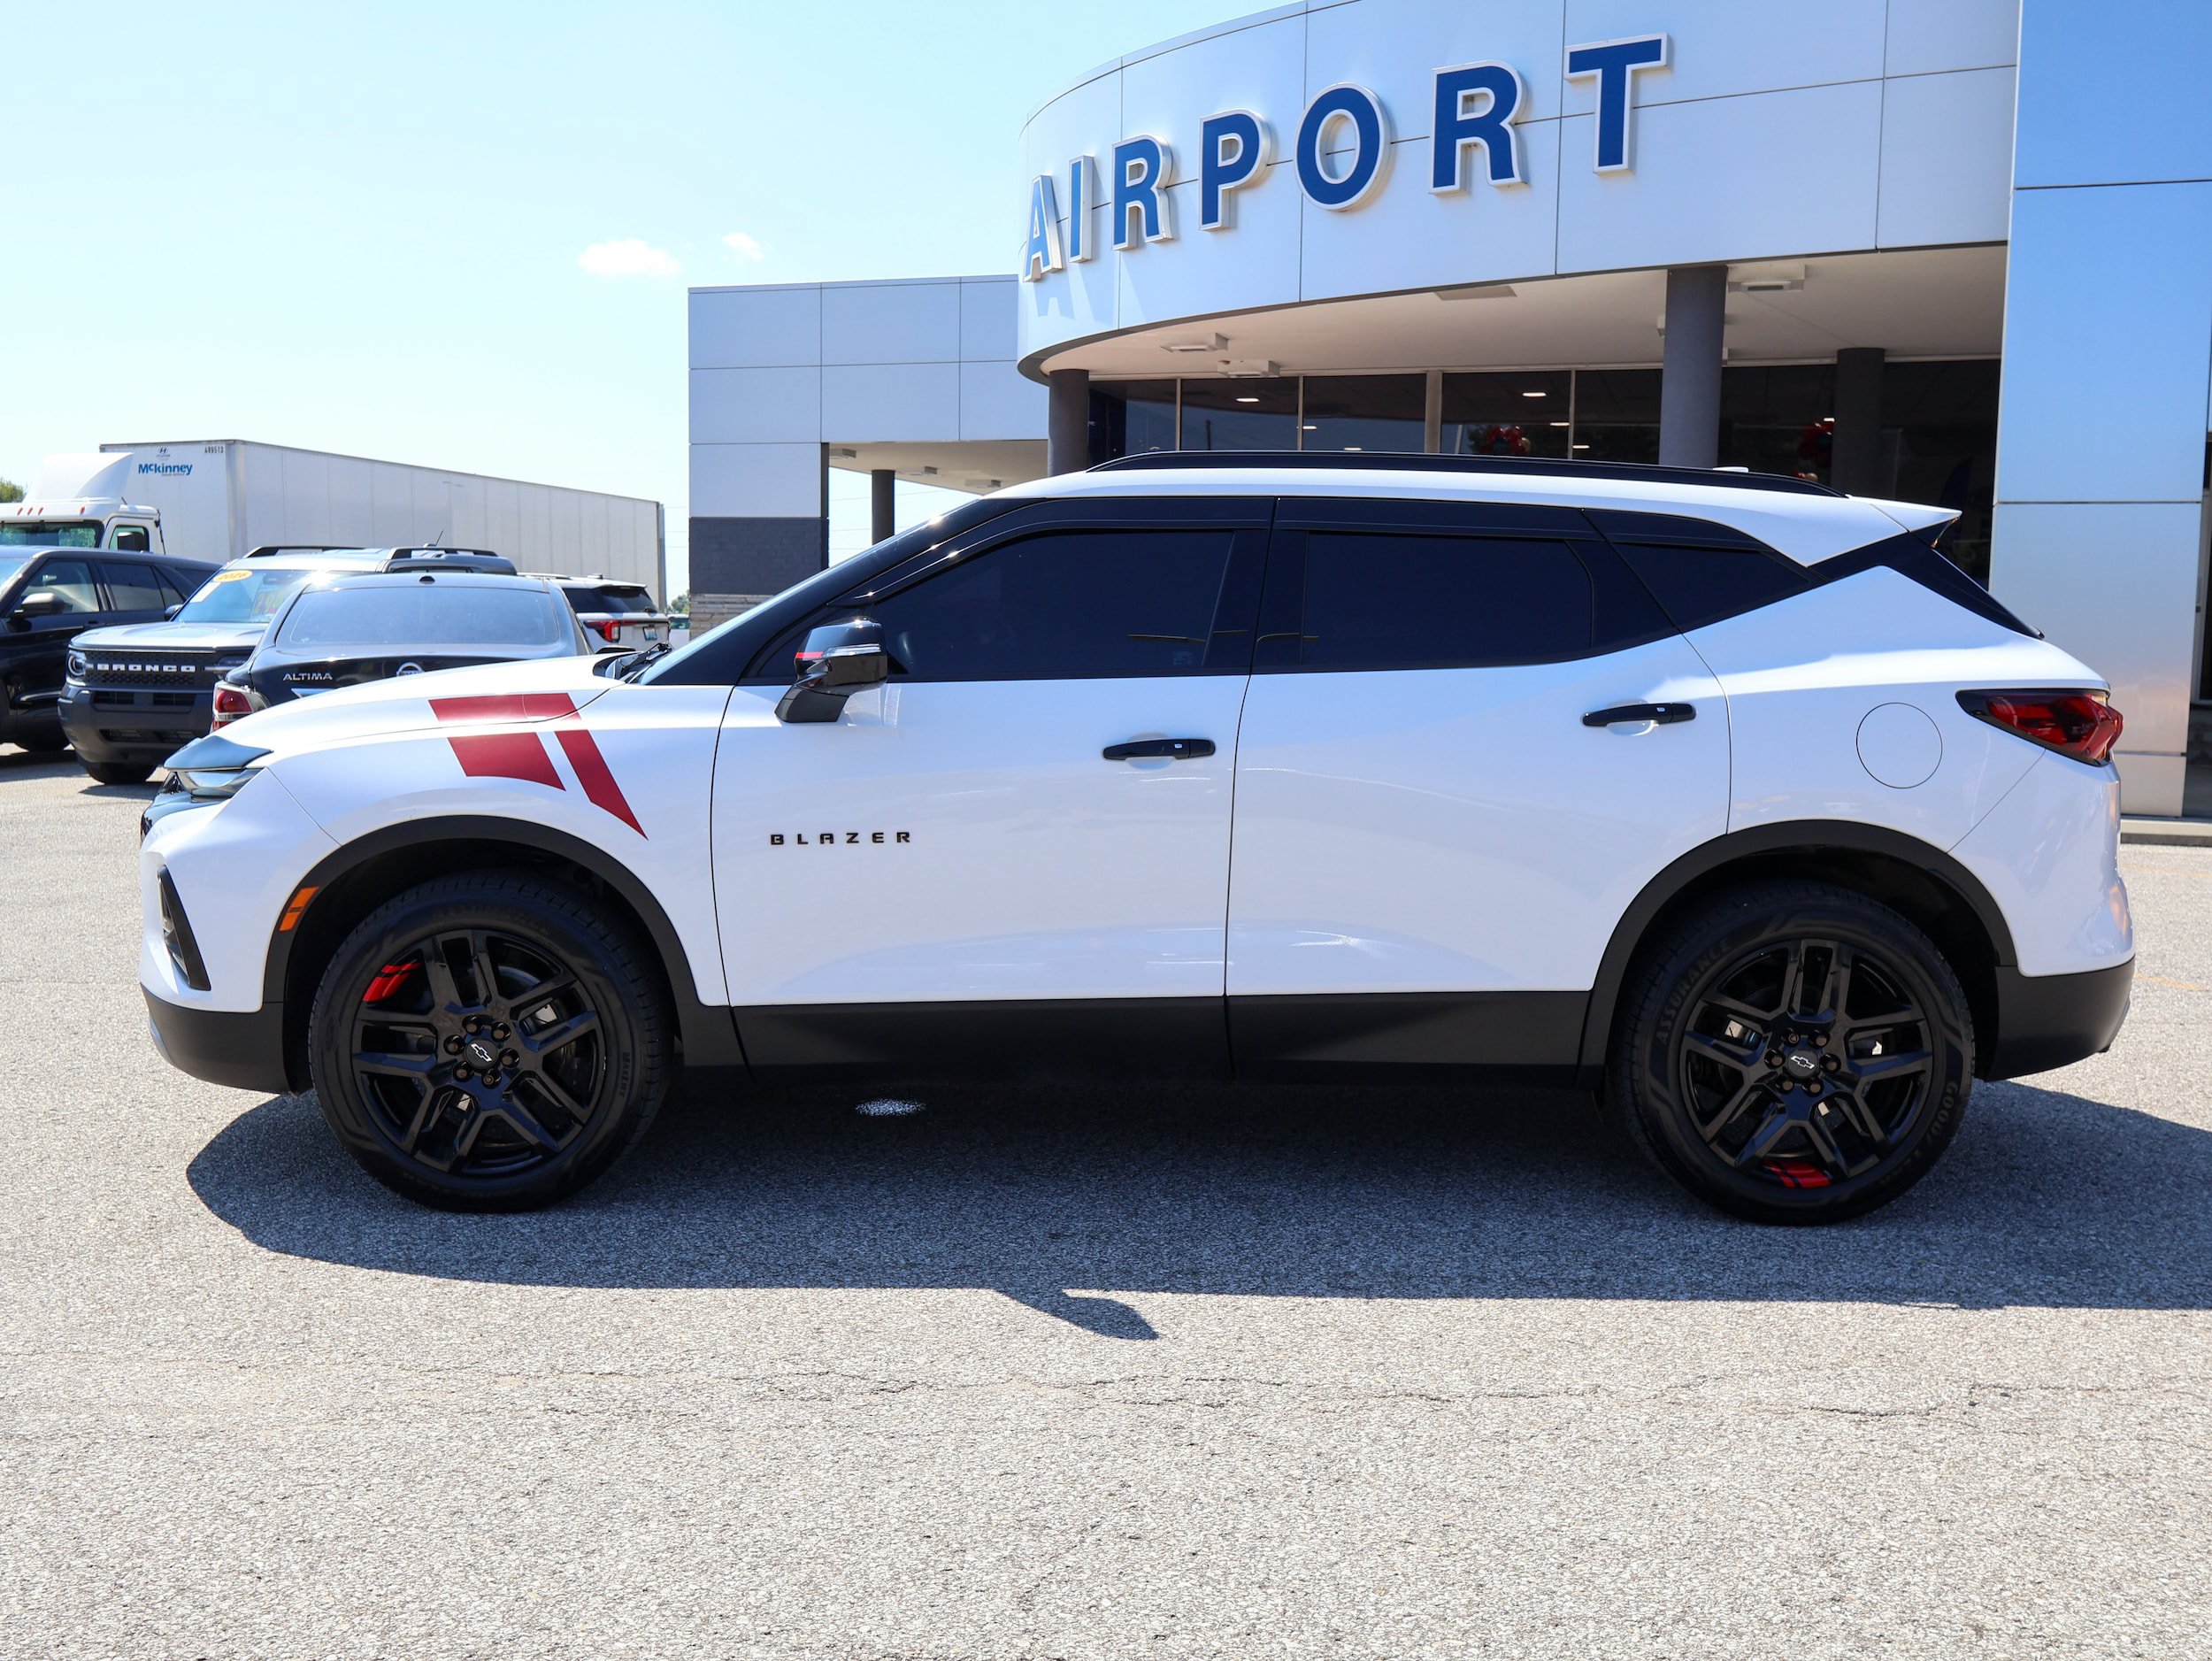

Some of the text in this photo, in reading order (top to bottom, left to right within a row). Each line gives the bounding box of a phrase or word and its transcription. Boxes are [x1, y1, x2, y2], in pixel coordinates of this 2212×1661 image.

[1023, 31, 1675, 284] AIRPORT
[96, 663, 196, 673] BRONCO
[283, 673, 334, 681] ALTIMA
[770, 831, 910, 845] BLAZER
[1656, 938, 1732, 1043] ASSURANCE
